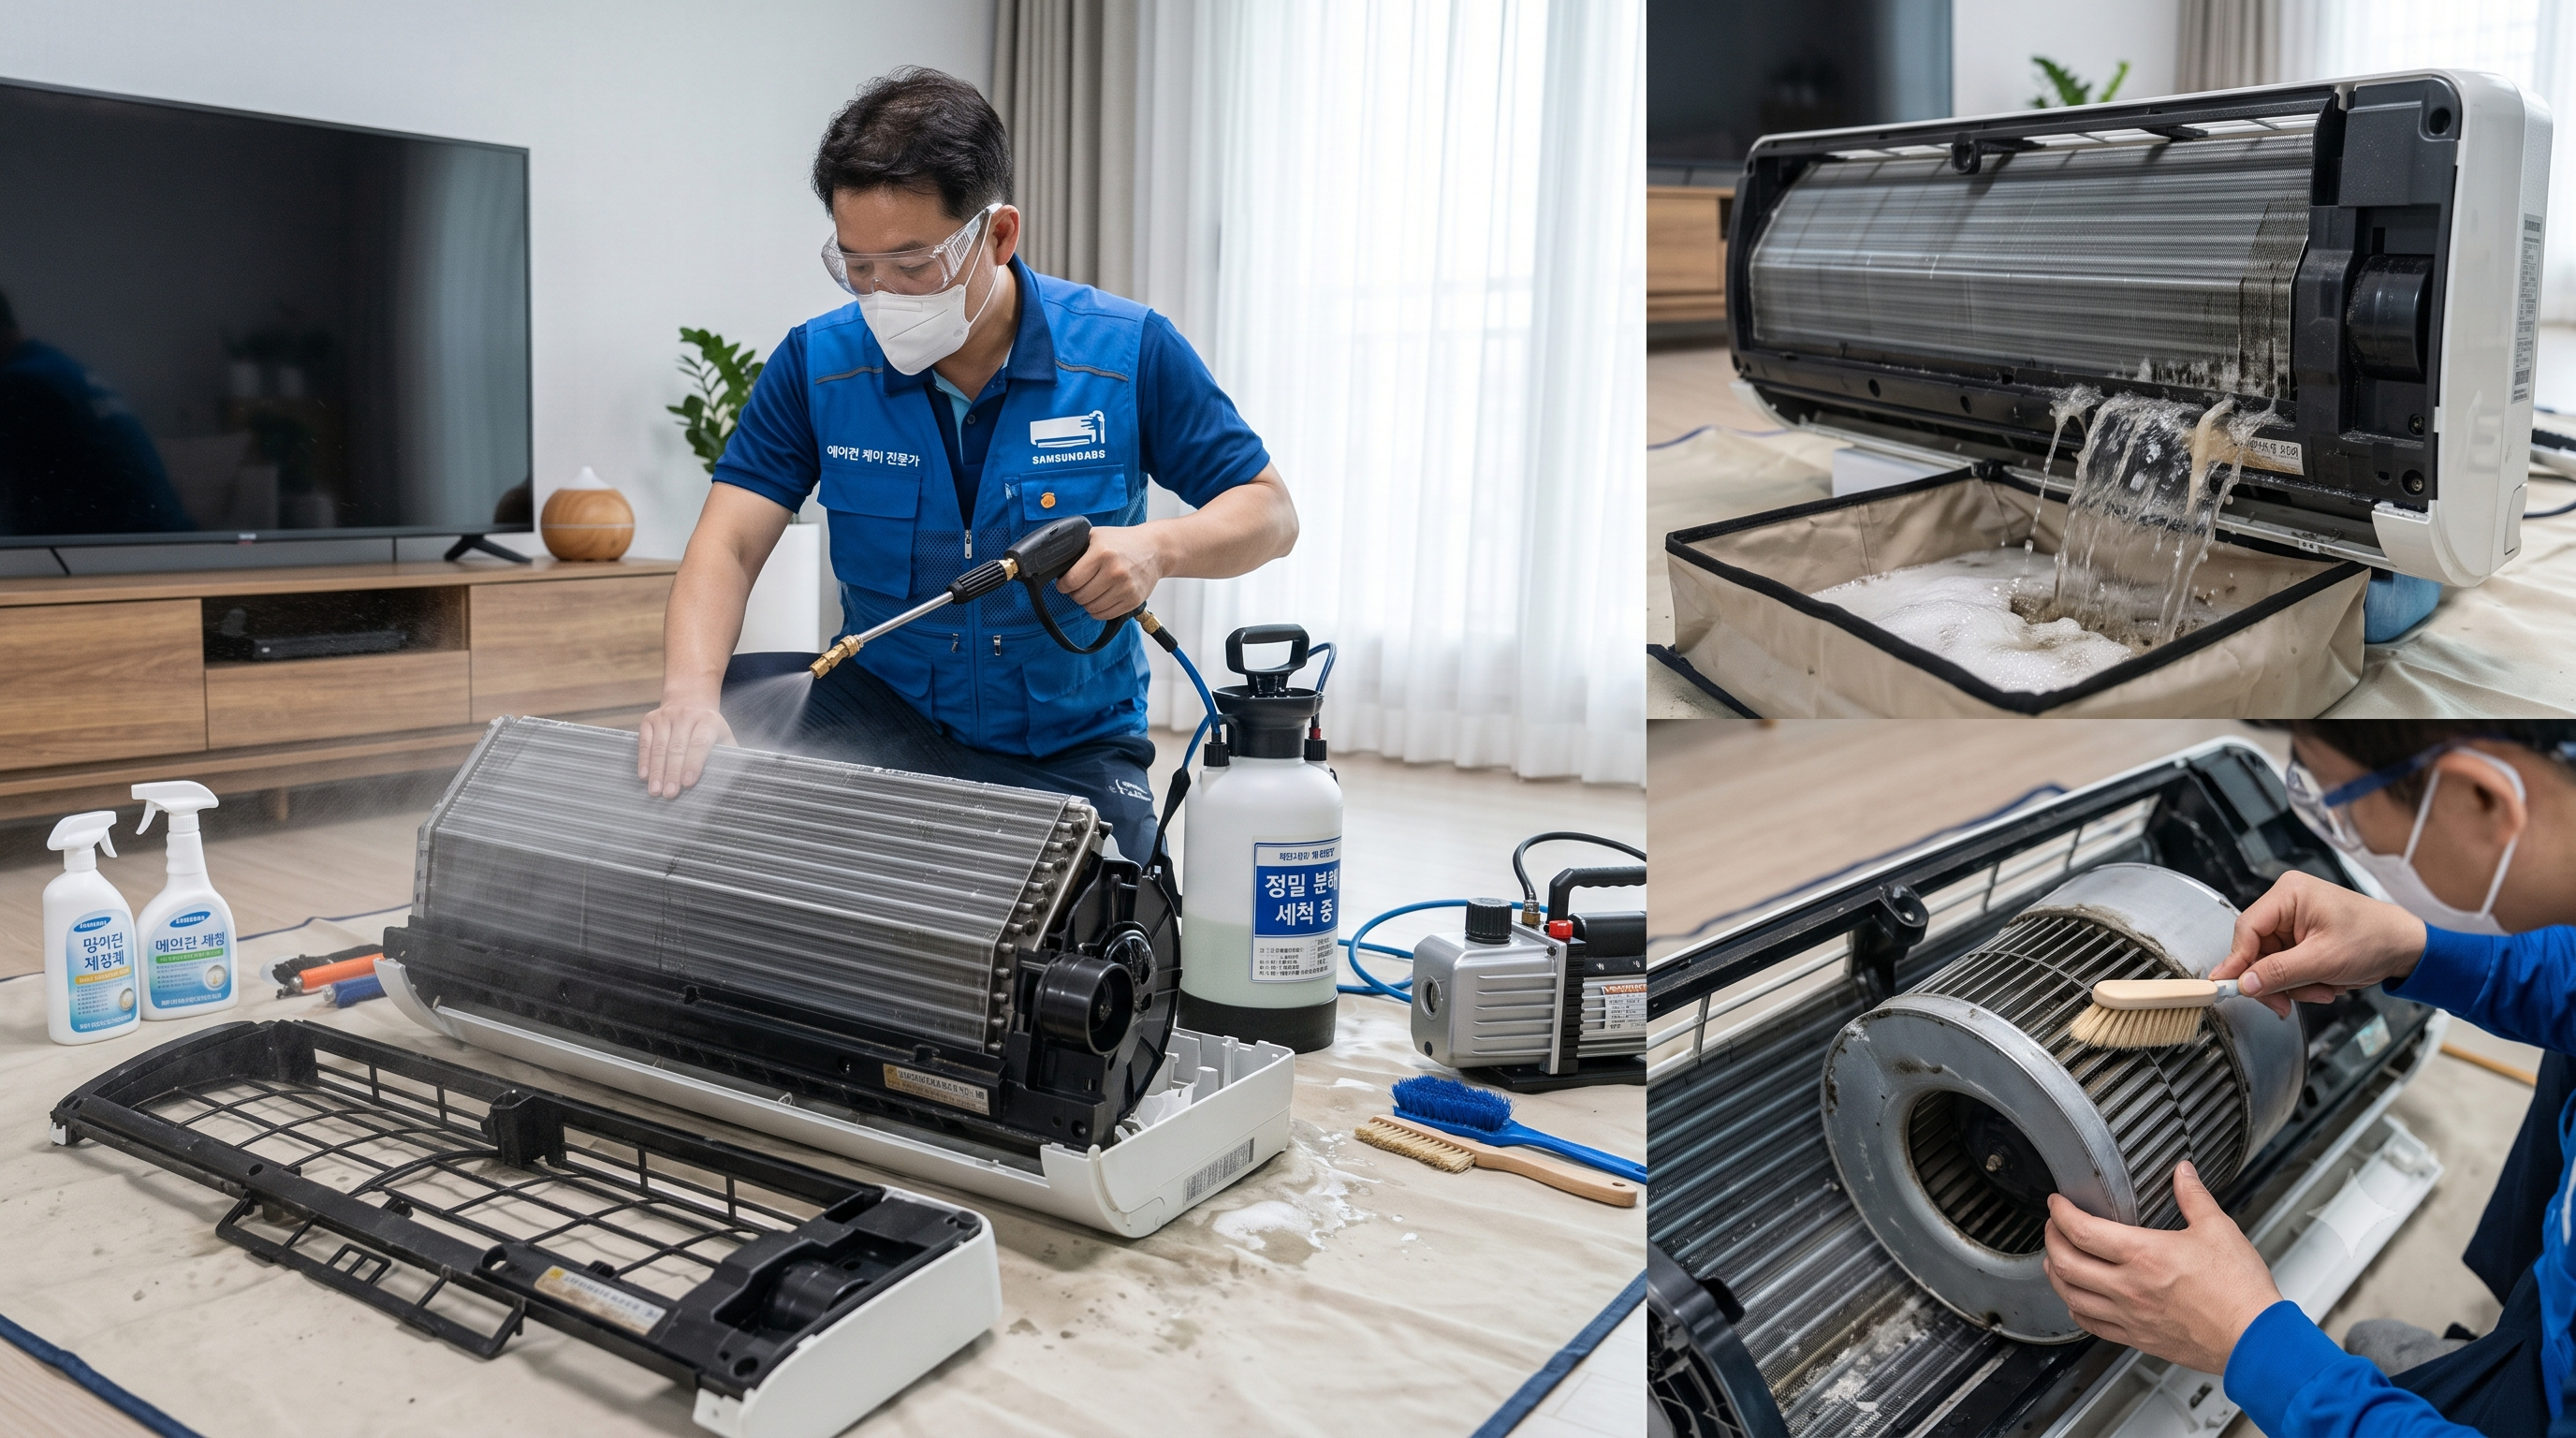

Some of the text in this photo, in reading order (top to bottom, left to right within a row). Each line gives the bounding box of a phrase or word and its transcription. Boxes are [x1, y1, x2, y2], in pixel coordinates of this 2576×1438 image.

[1265, 867, 1339, 898] 정밀 분해
[1275, 899, 1333, 926] 세척 중
